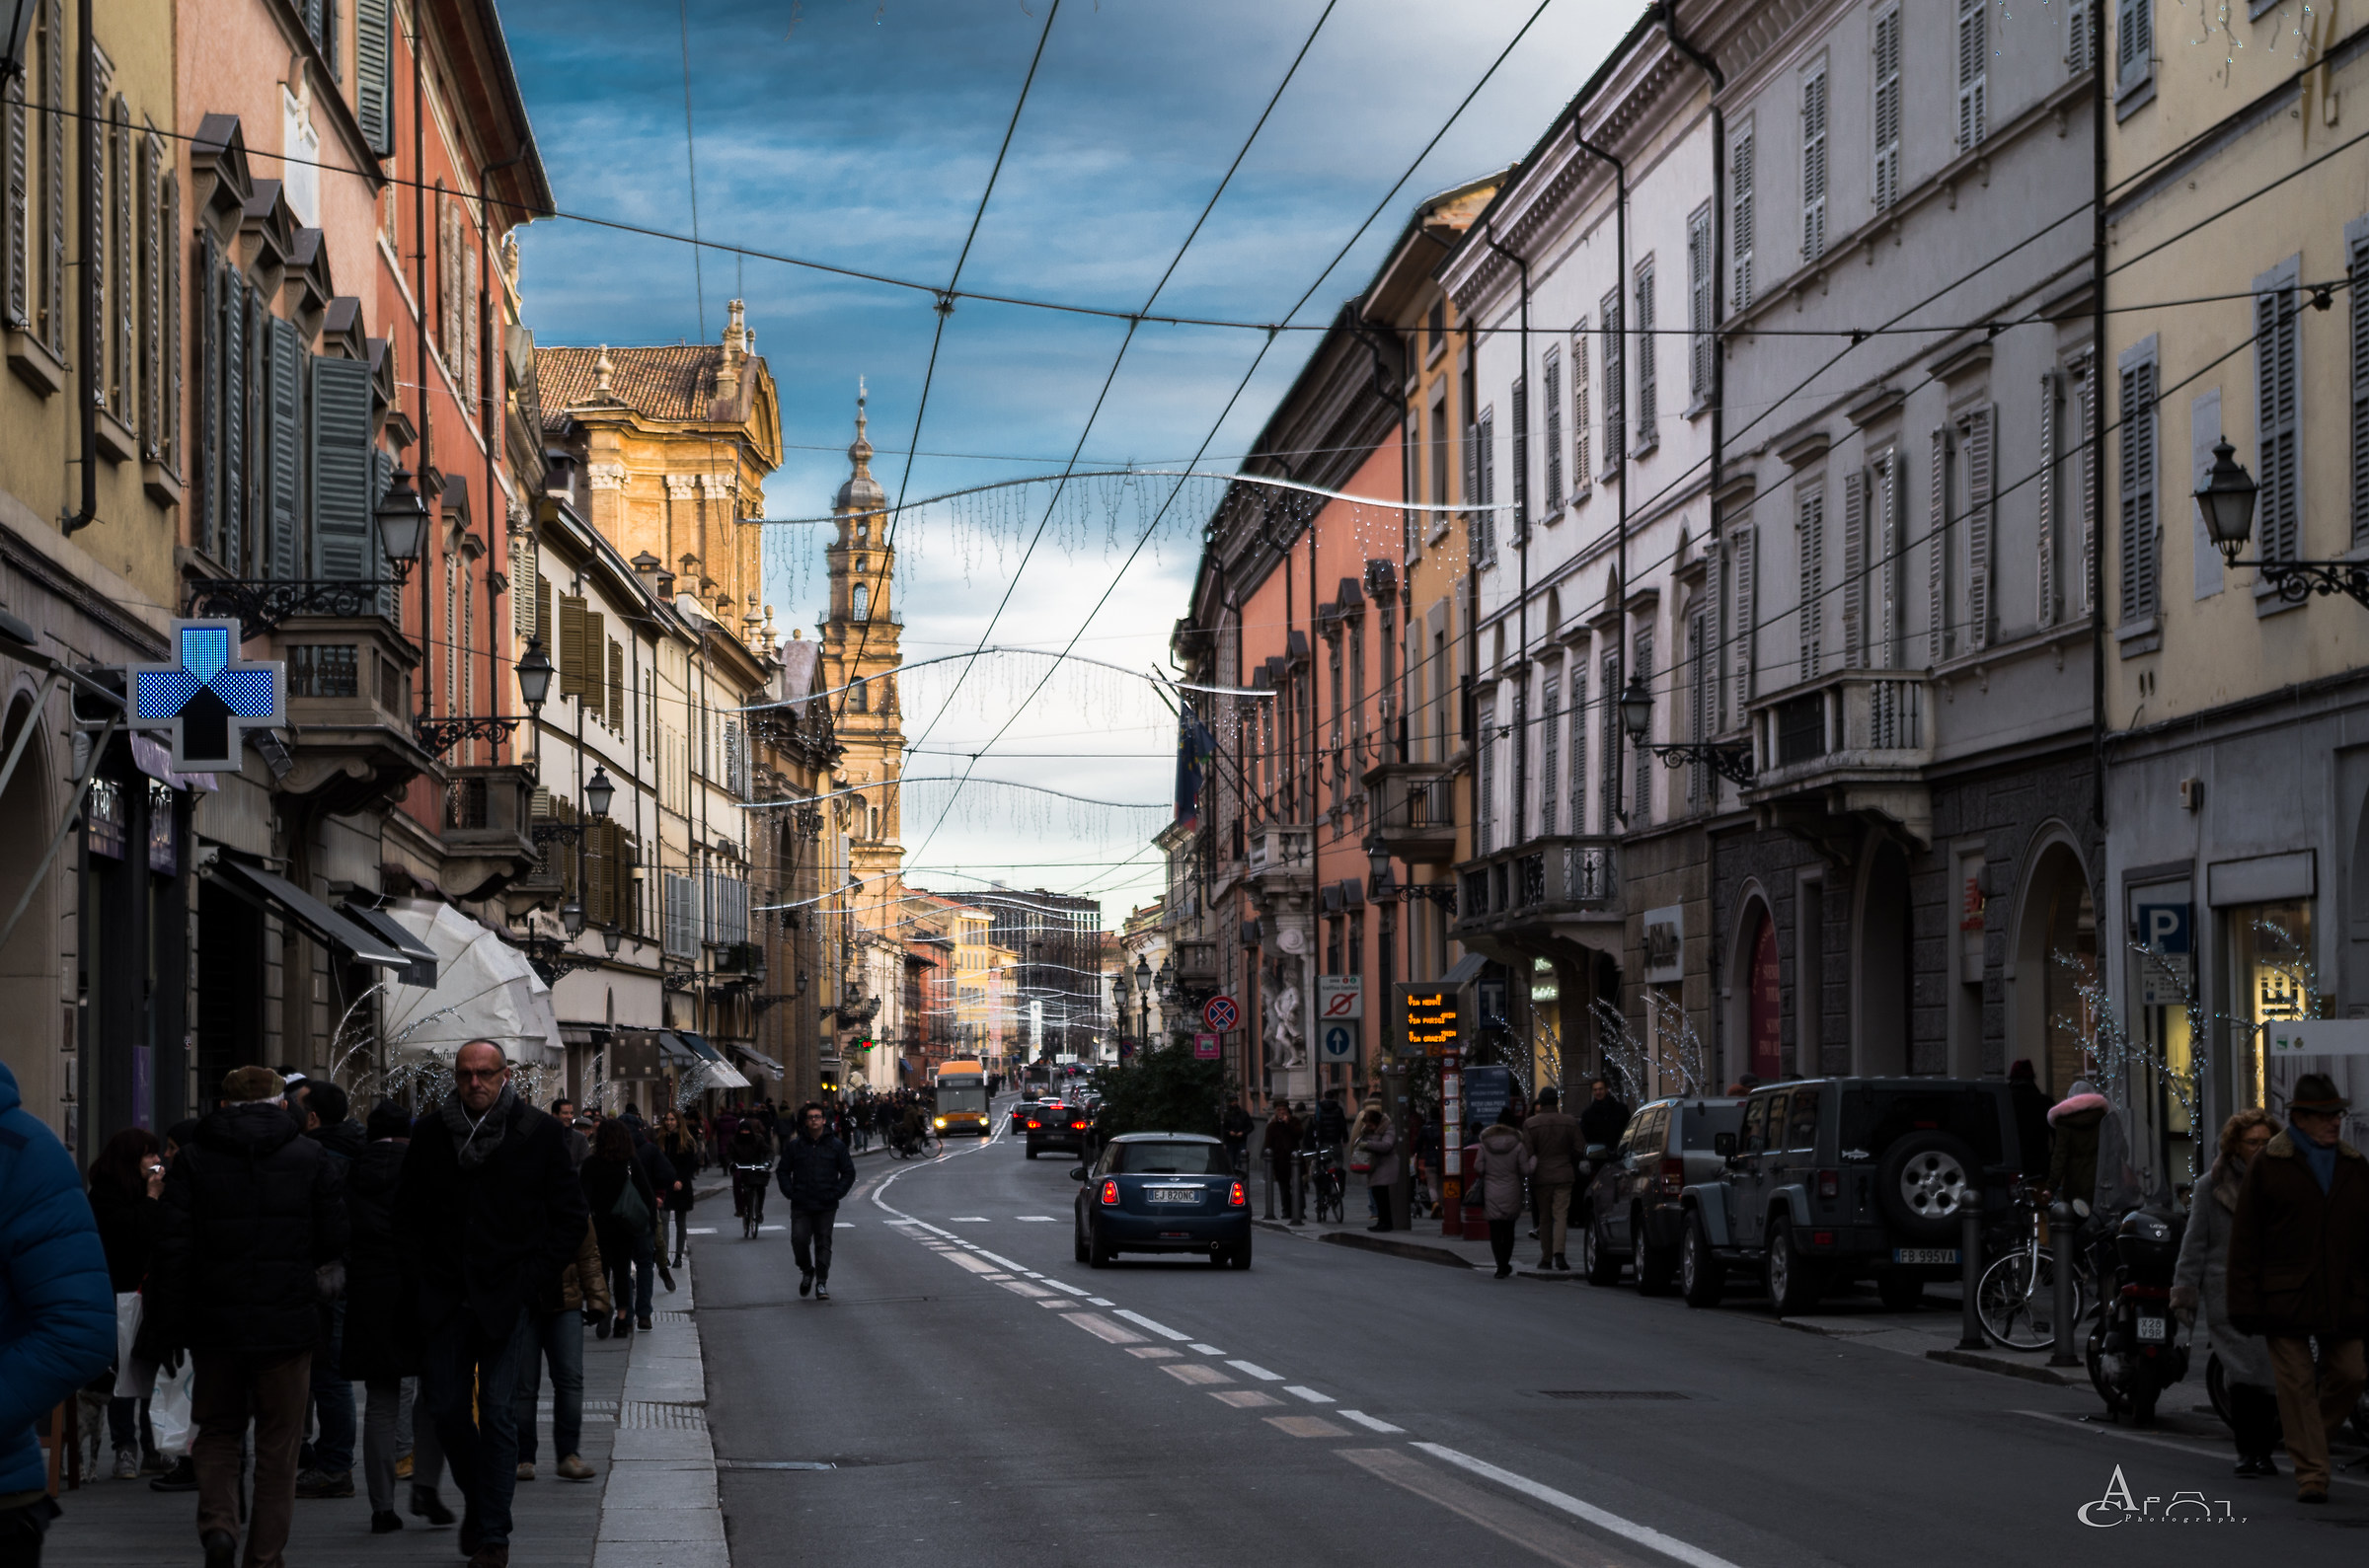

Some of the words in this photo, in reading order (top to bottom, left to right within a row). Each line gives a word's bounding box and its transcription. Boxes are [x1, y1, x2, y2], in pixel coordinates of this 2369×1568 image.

[2149, 909, 2179, 951] P
[1154, 1191, 1165, 1200] EJ
[1901, 1250, 1915, 1262] FB
[1919, 1250, 1954, 1262] 995VA
